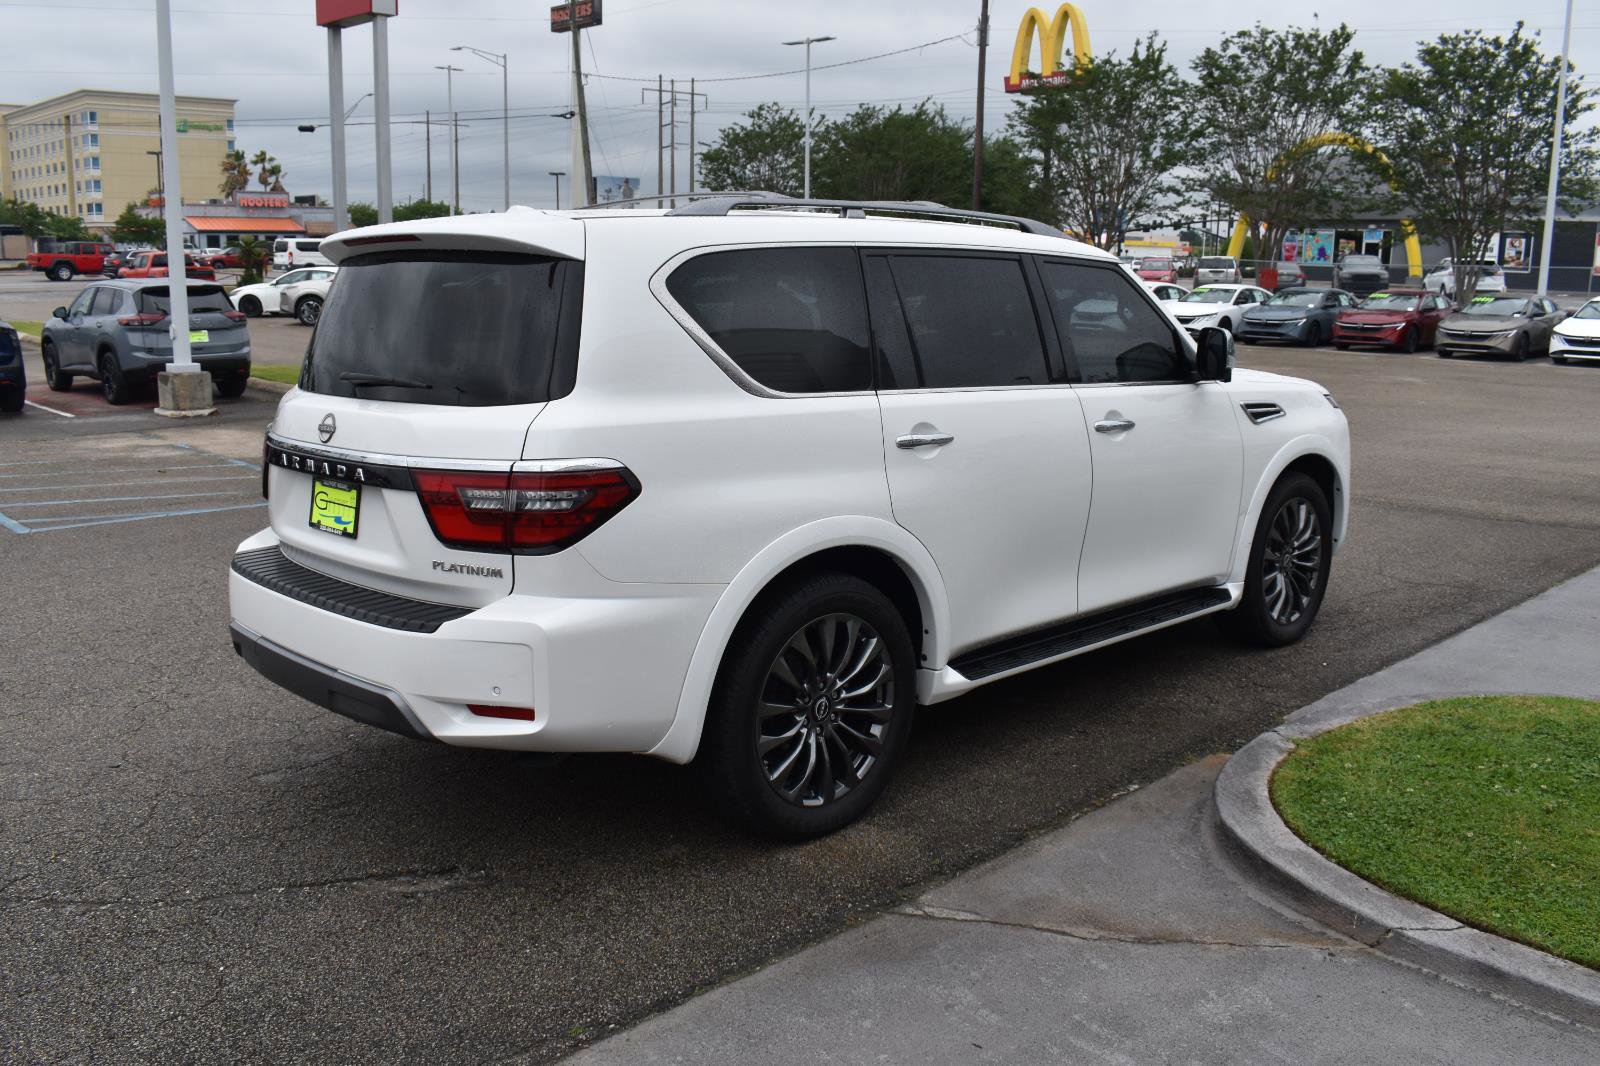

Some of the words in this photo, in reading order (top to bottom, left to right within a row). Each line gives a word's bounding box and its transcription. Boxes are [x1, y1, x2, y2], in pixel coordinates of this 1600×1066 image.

[240, 197, 288, 208] HOOTERS
[281, 453, 365, 482] ARMADA
[432, 560, 503, 578] PLATINUM
